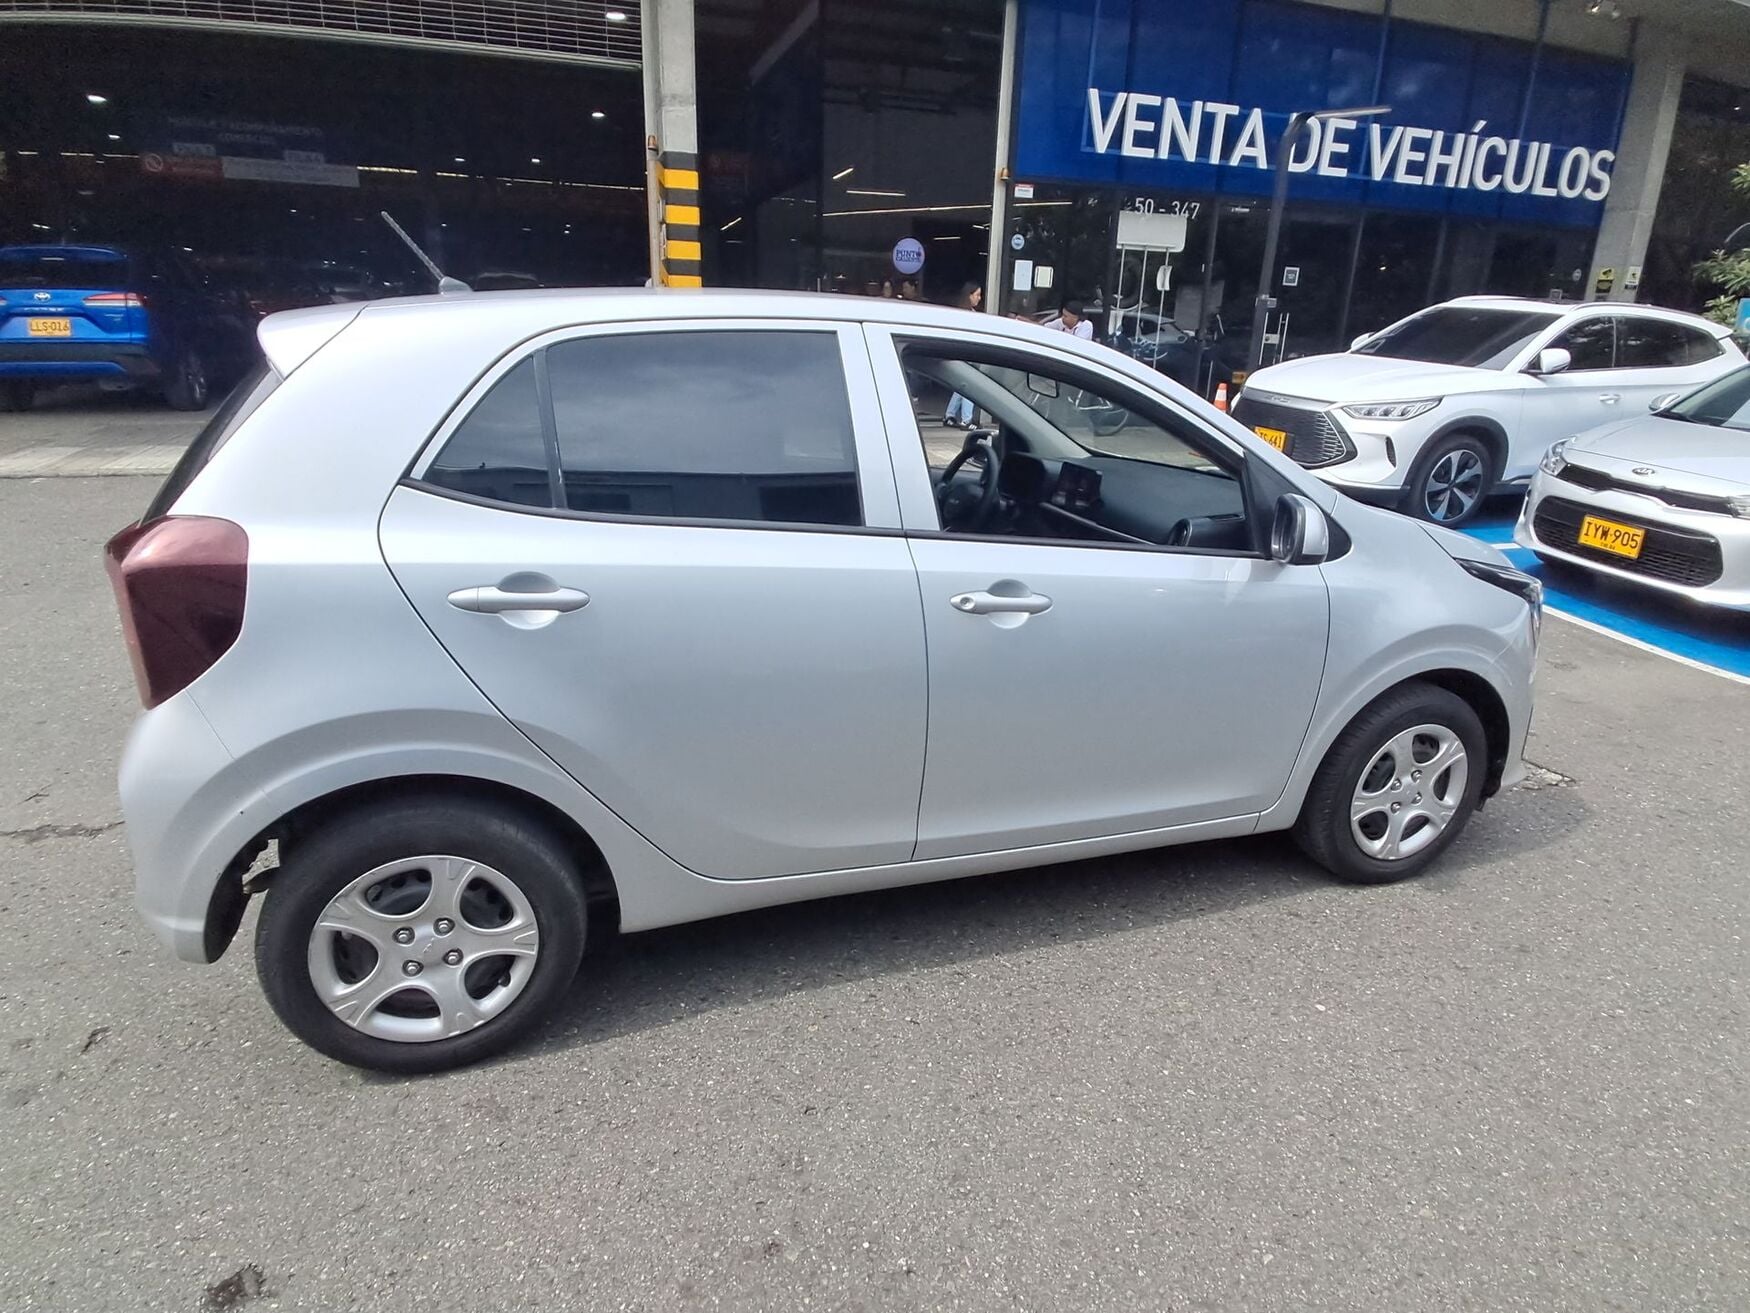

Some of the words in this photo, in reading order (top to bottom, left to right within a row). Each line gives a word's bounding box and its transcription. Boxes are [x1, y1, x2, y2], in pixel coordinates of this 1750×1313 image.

[1088, 88, 1267, 170] VENTA
[1288, 112, 1357, 177] DE
[1370, 120, 1615, 201] VEHÍCULOS
[1135, 197, 1154, 215] 50
[1170, 201, 1200, 219] 347
